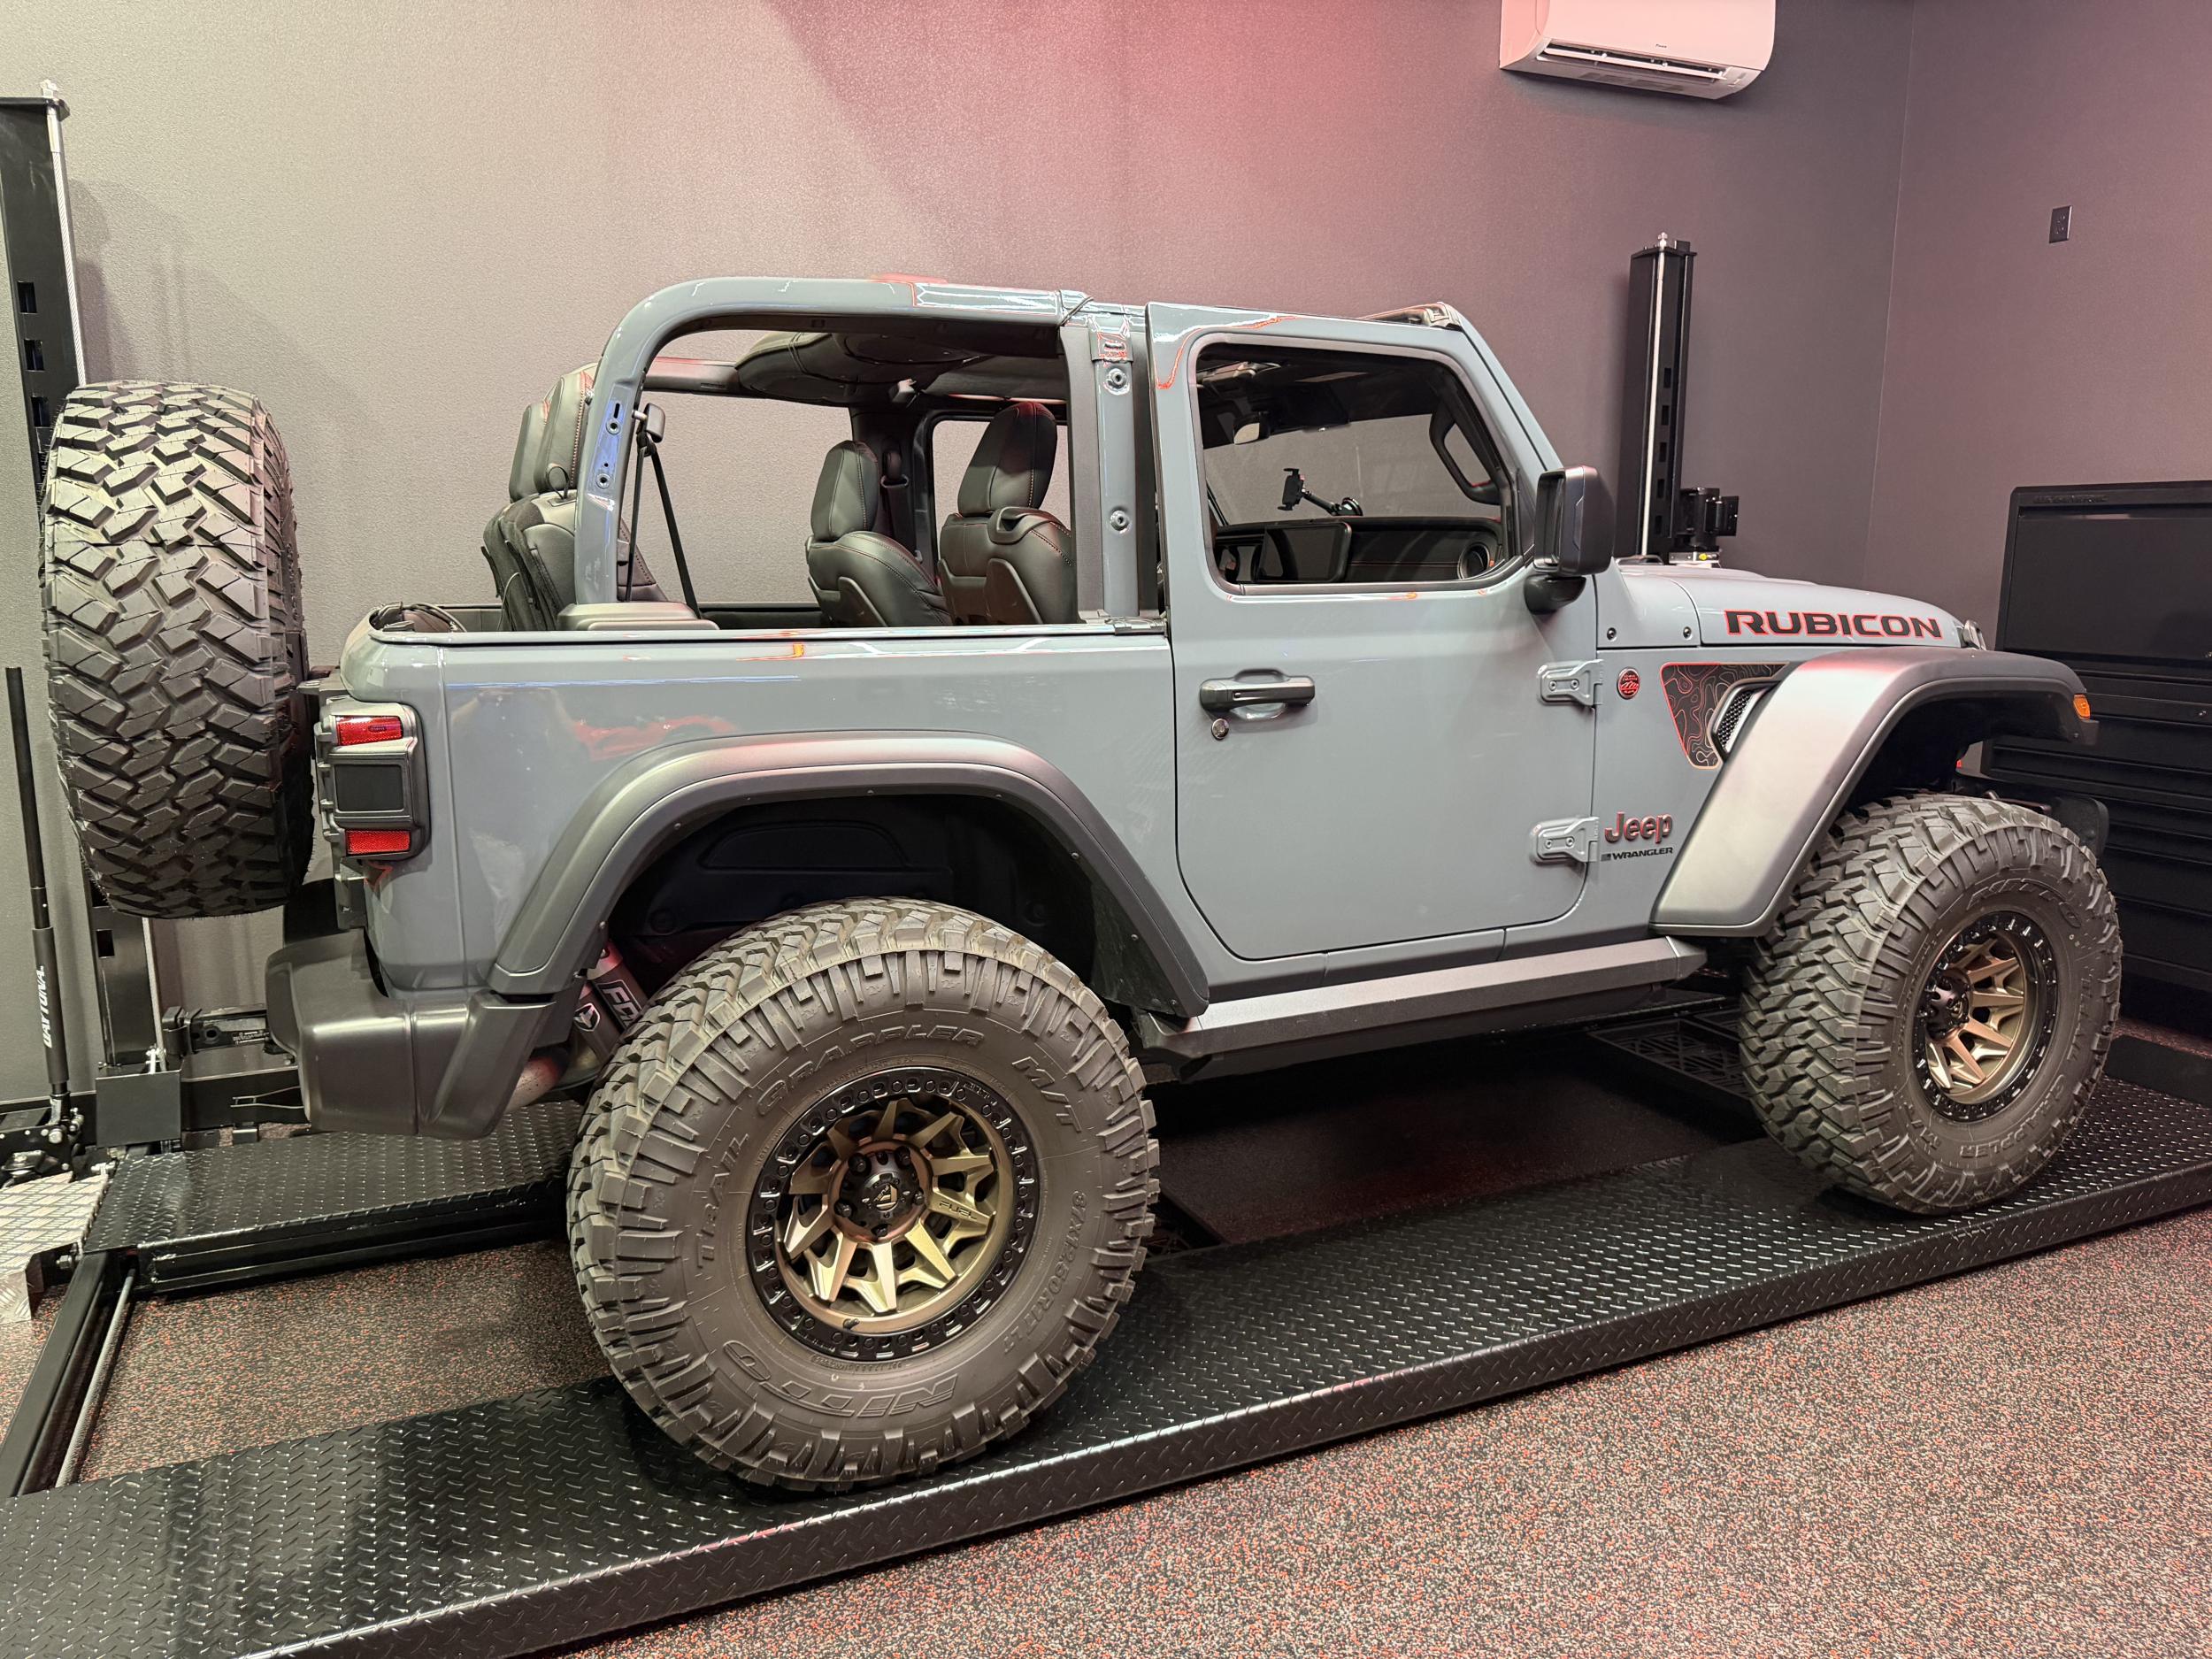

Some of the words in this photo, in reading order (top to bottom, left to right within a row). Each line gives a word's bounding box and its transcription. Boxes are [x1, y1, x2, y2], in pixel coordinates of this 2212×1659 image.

[1724, 610, 1943, 640] RUBICON
[1604, 811, 1673, 844] Jeep
[1611, 847, 1673, 860] WRANGLER
[1966, 876, 2082, 928] NITTO
[695, 1133, 749, 1270] TRAIL
[757, 1024, 986, 1117] GRAPPLER
[1011, 1056, 1082, 1133] M/T
[939, 1200, 978, 1220] FUEL
[722, 1339, 958, 1418] NITTO
